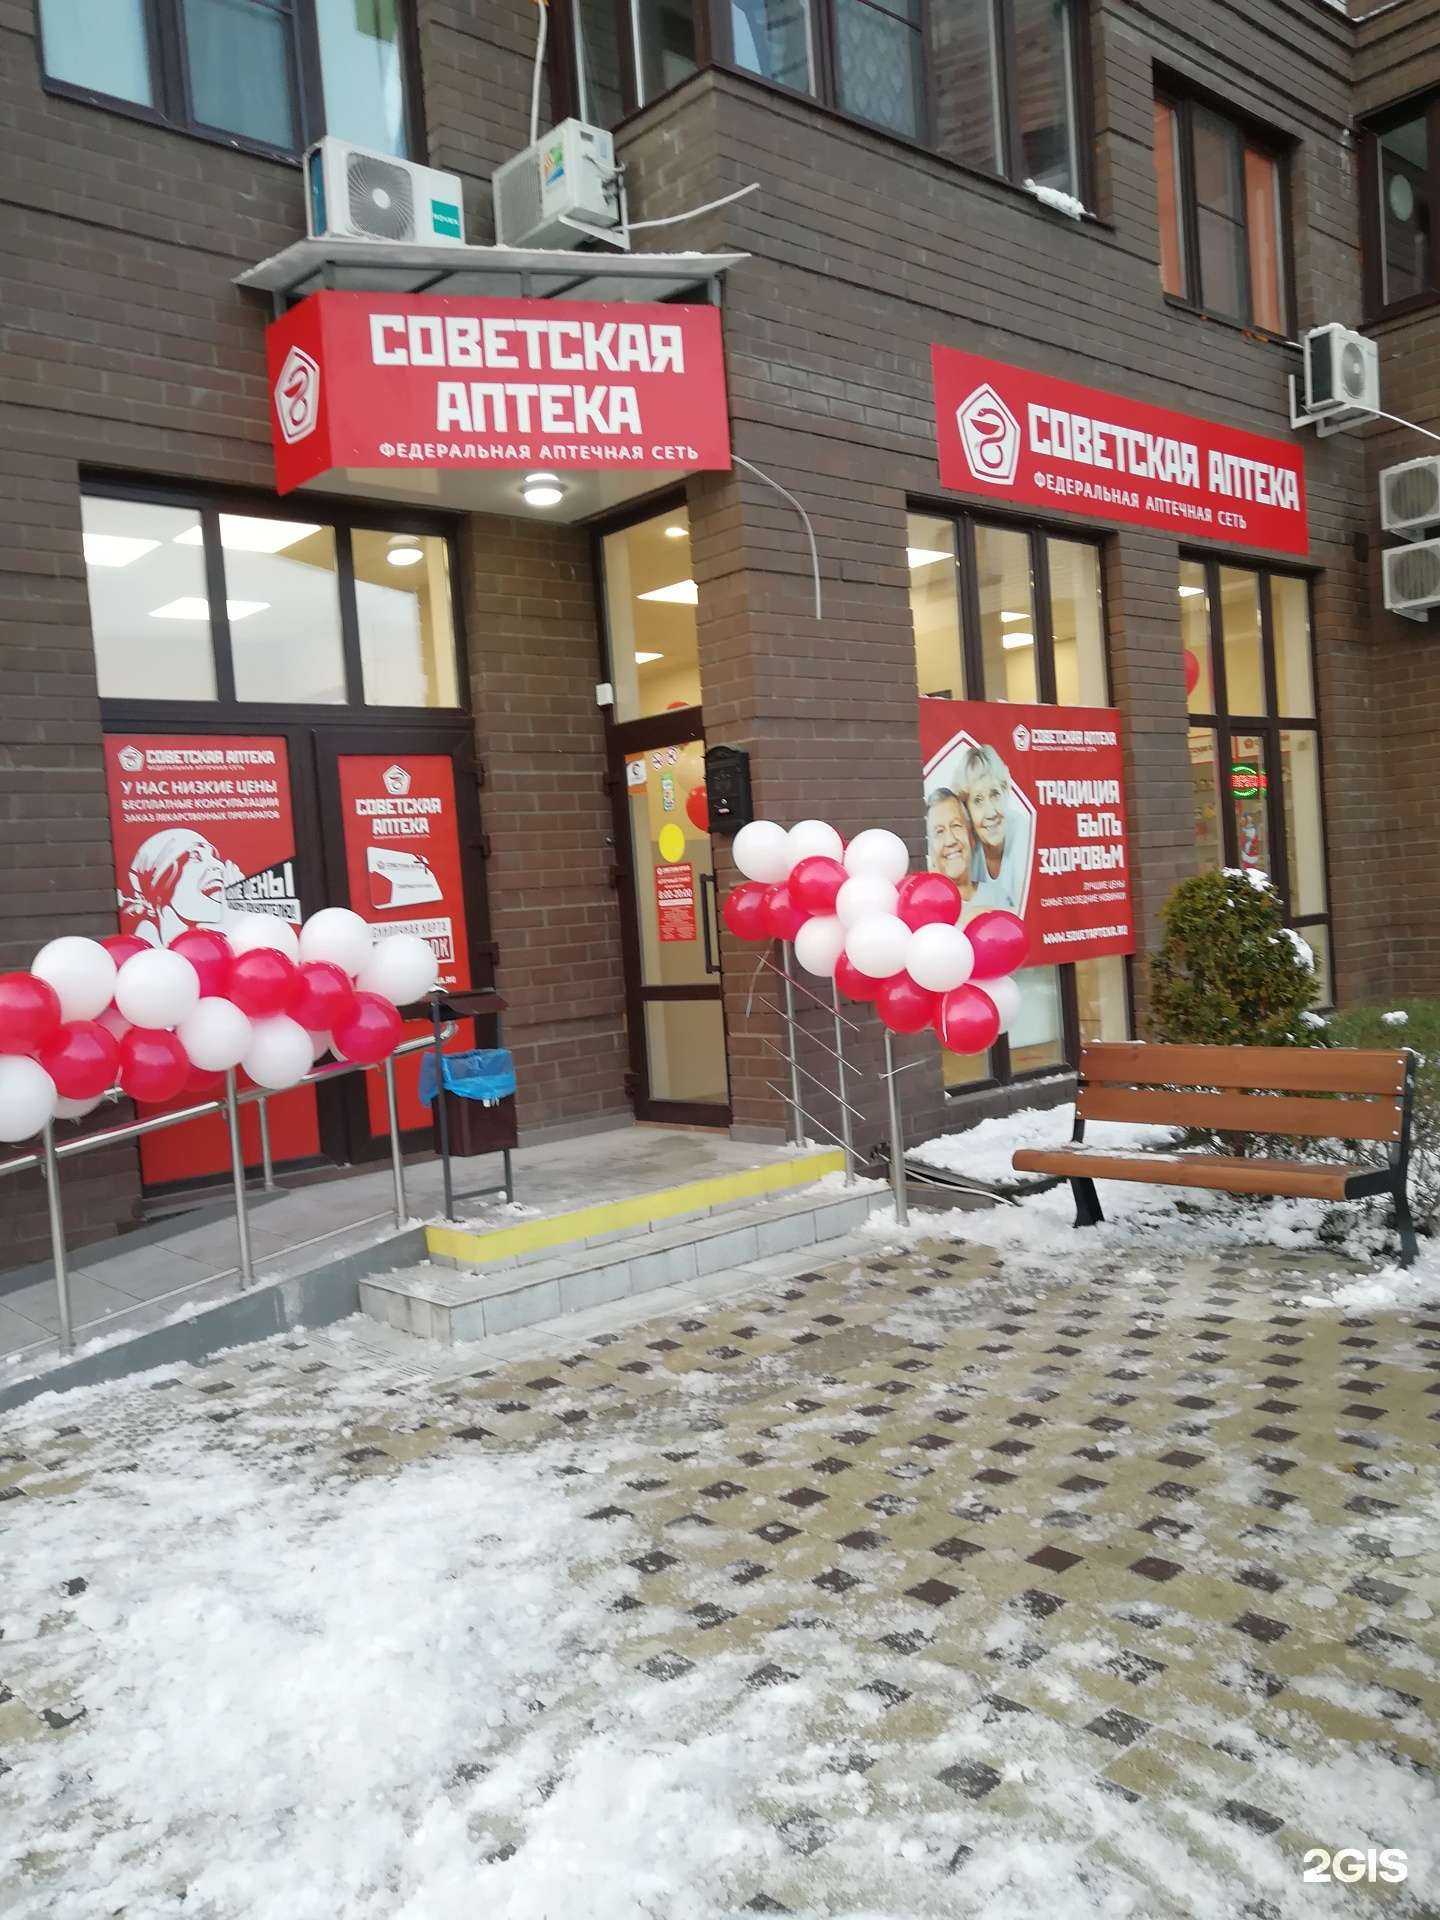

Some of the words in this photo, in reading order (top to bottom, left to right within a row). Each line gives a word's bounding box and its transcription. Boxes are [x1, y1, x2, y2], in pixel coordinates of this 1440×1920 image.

[369, 313, 685, 373] СОВЕТСКАЯ
[436, 381, 643, 434] АПТЕКА
[379, 442, 531, 461] ФЕДЕРАЛЬНАЯ
[539, 444, 644, 460] АПТЕЧНАЯ
[651, 446, 699, 460] СЕТЬ
[1027, 402, 1200, 489] СОВЕТСКАЯ
[1208, 449, 1300, 512] АПТЕКА
[1033, 471, 1140, 509] ФЕДЕРАЛЬНАЯ
[1145, 496, 1212, 523] АПТЕЧНАЯ
[1218, 511, 1247, 530] СЕТЬ
[145, 750, 223, 765] СОВЕТСКАЯ
[225, 750, 276, 765] АПТЕКА
[120, 781, 132, 795] У
[135, 781, 169, 795] НАС
[171, 780, 234, 795] НИЗКИЕ
[236, 780, 278, 796] ЦЕНЫ
[1035, 780, 1120, 807] ТРАДИЦИЯ
[355, 798, 442, 816] СОВЕТСКАЯ
[372, 817, 430, 835] АПТЕКА
[1077, 813, 1122, 837] БЫТЬ
[1038, 845, 1125, 875] ЗДОРОВЫМ
